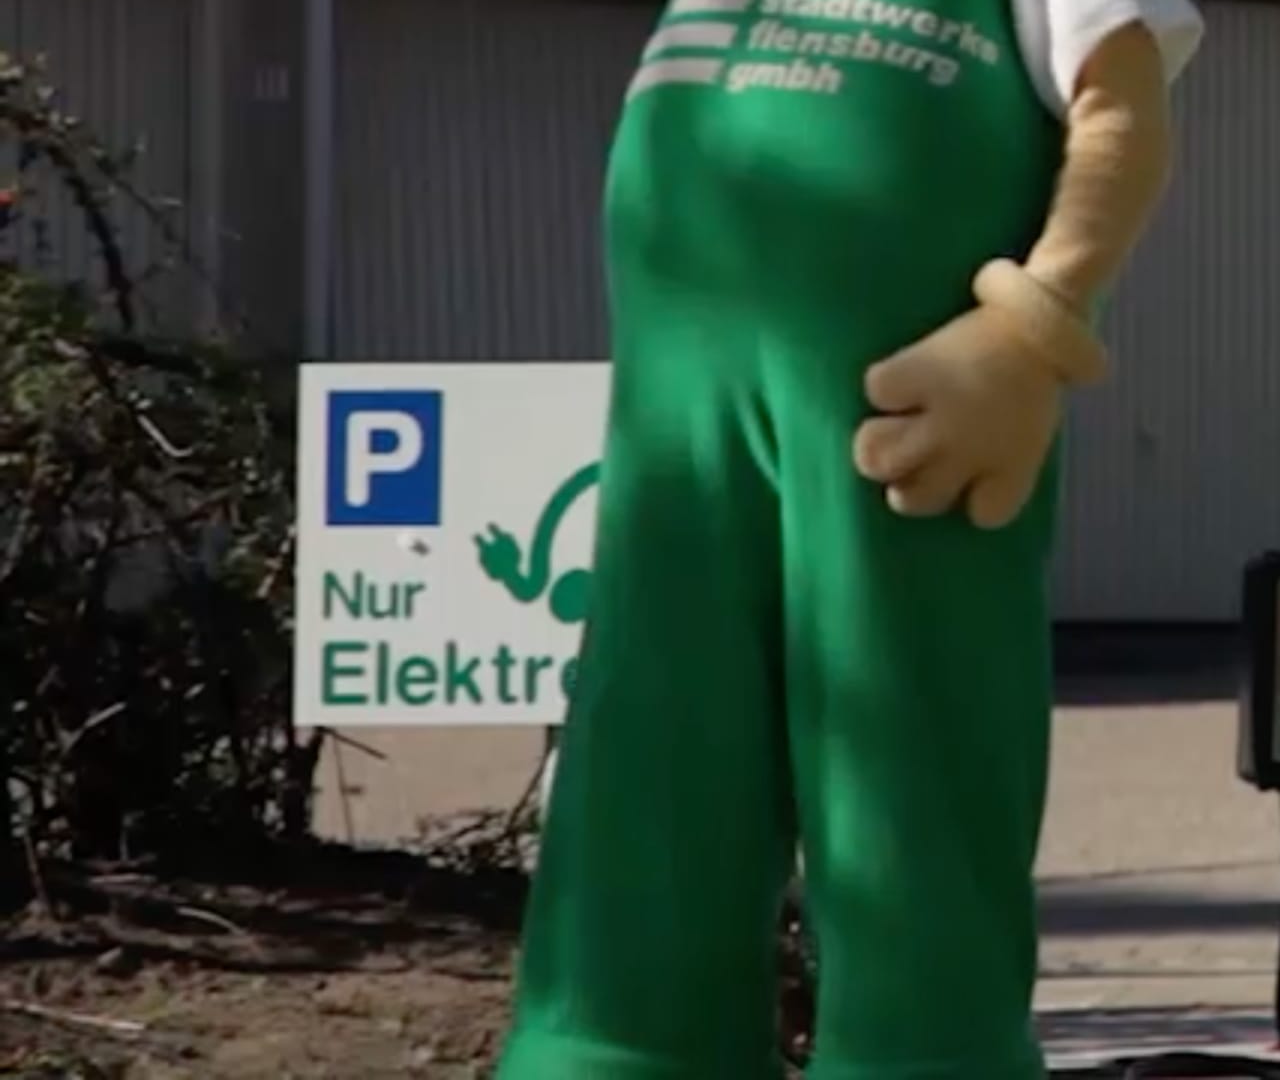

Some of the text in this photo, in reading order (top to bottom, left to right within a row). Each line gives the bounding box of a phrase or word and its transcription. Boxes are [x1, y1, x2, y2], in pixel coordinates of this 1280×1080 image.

[725, 59, 842, 94] gmbh
[748, 20, 960, 86] flensburg
[344, 409, 424, 508] P
[322, 570, 426, 620] Nur
